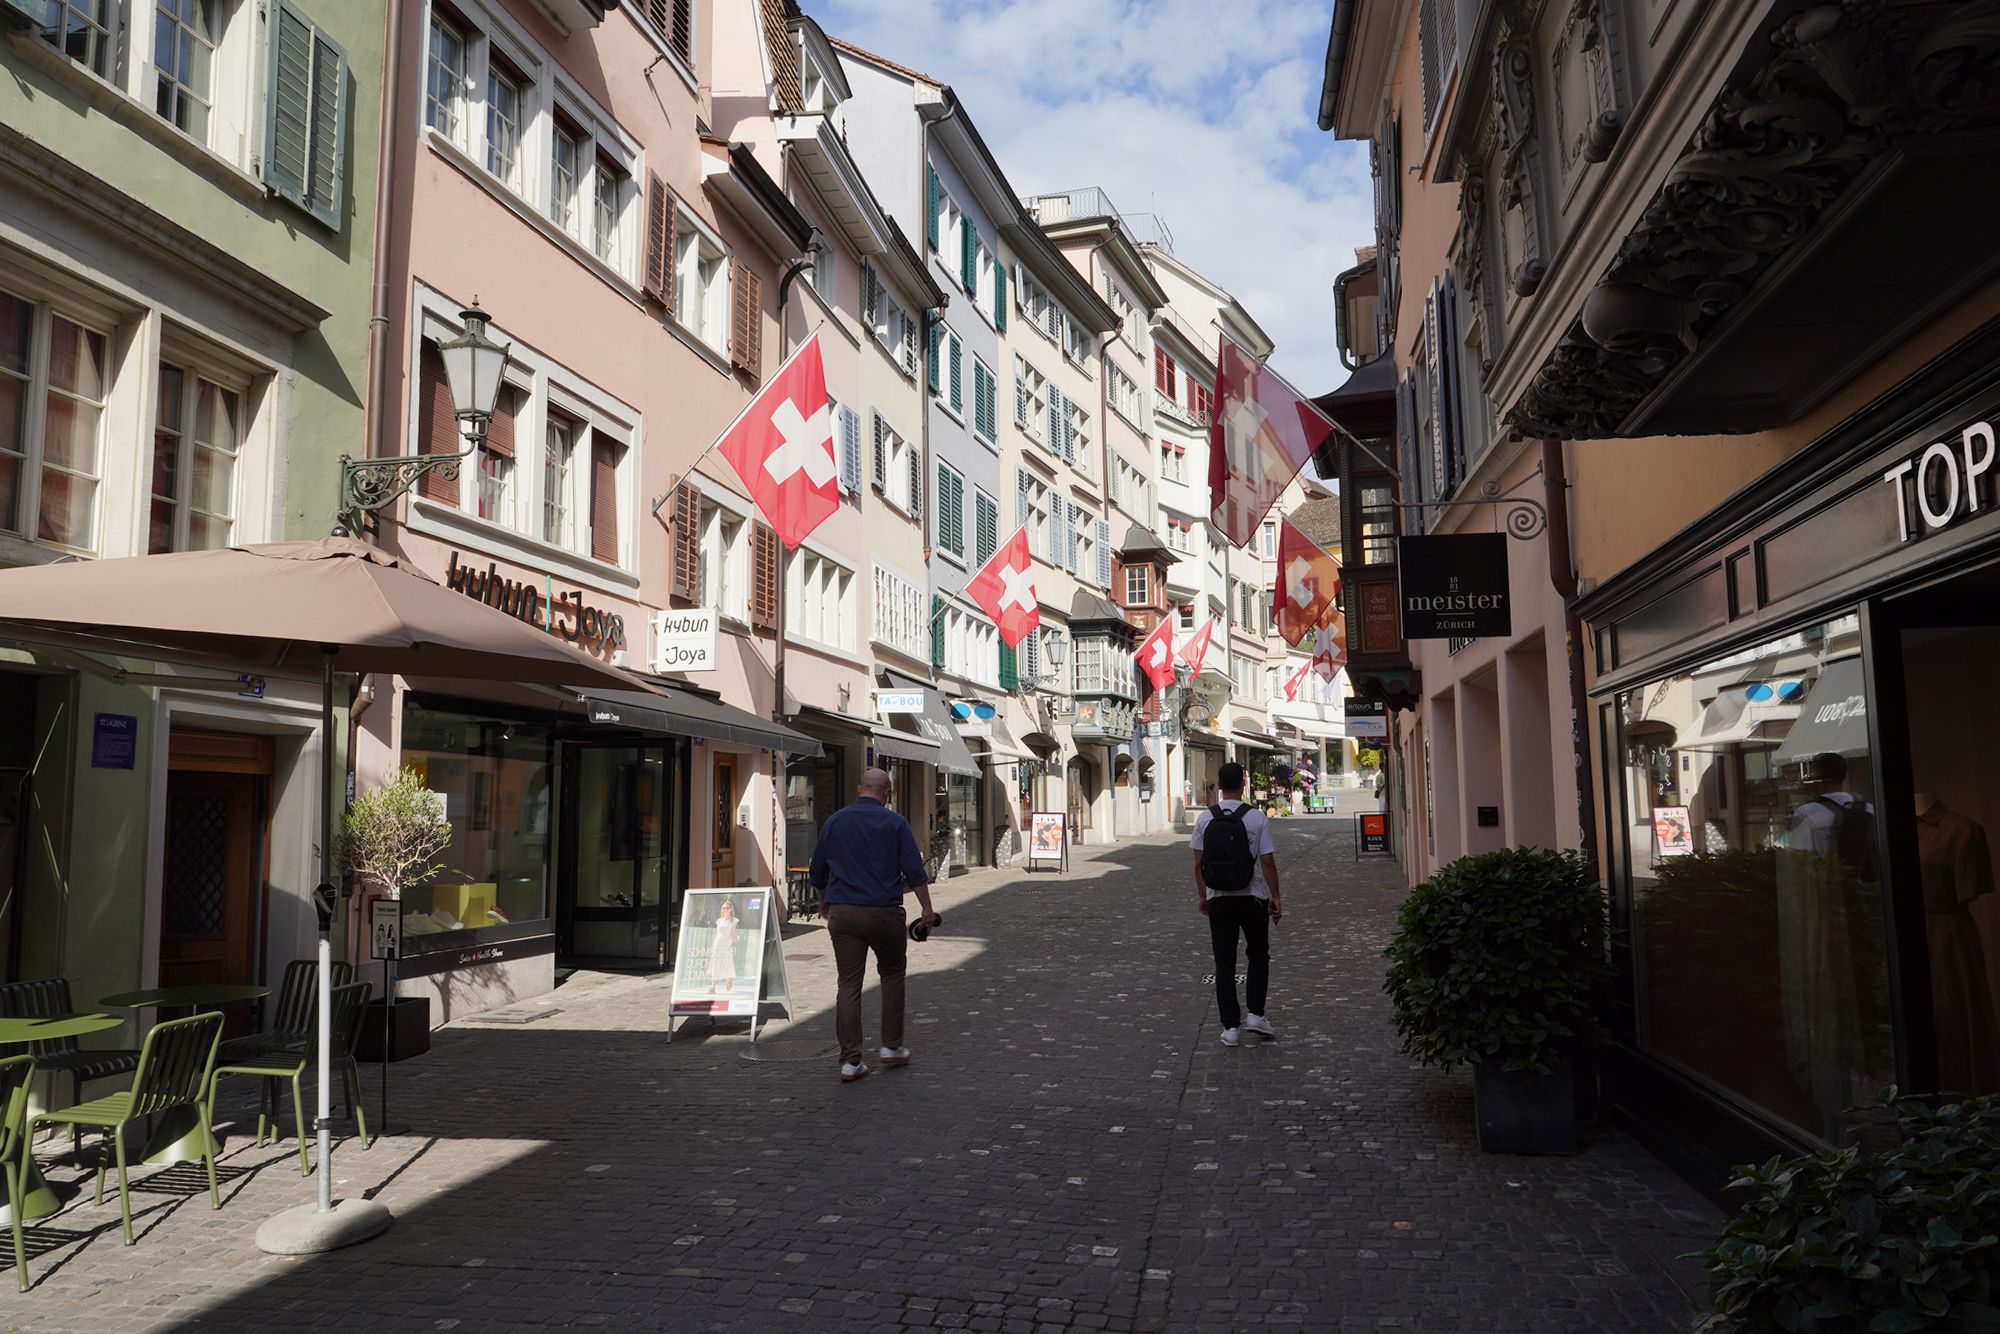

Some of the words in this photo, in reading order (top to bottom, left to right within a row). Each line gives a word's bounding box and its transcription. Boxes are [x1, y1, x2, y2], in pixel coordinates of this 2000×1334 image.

[1884, 421, 1996, 542] TOP
[1407, 592, 1503, 611] meister
[559, 591, 624, 652] Joya
[664, 616, 709, 633] kybun
[1436, 620, 1475, 629] ZÜRICH
[665, 646, 706, 665] Joya
[1346, 703, 1372, 711] airtours
